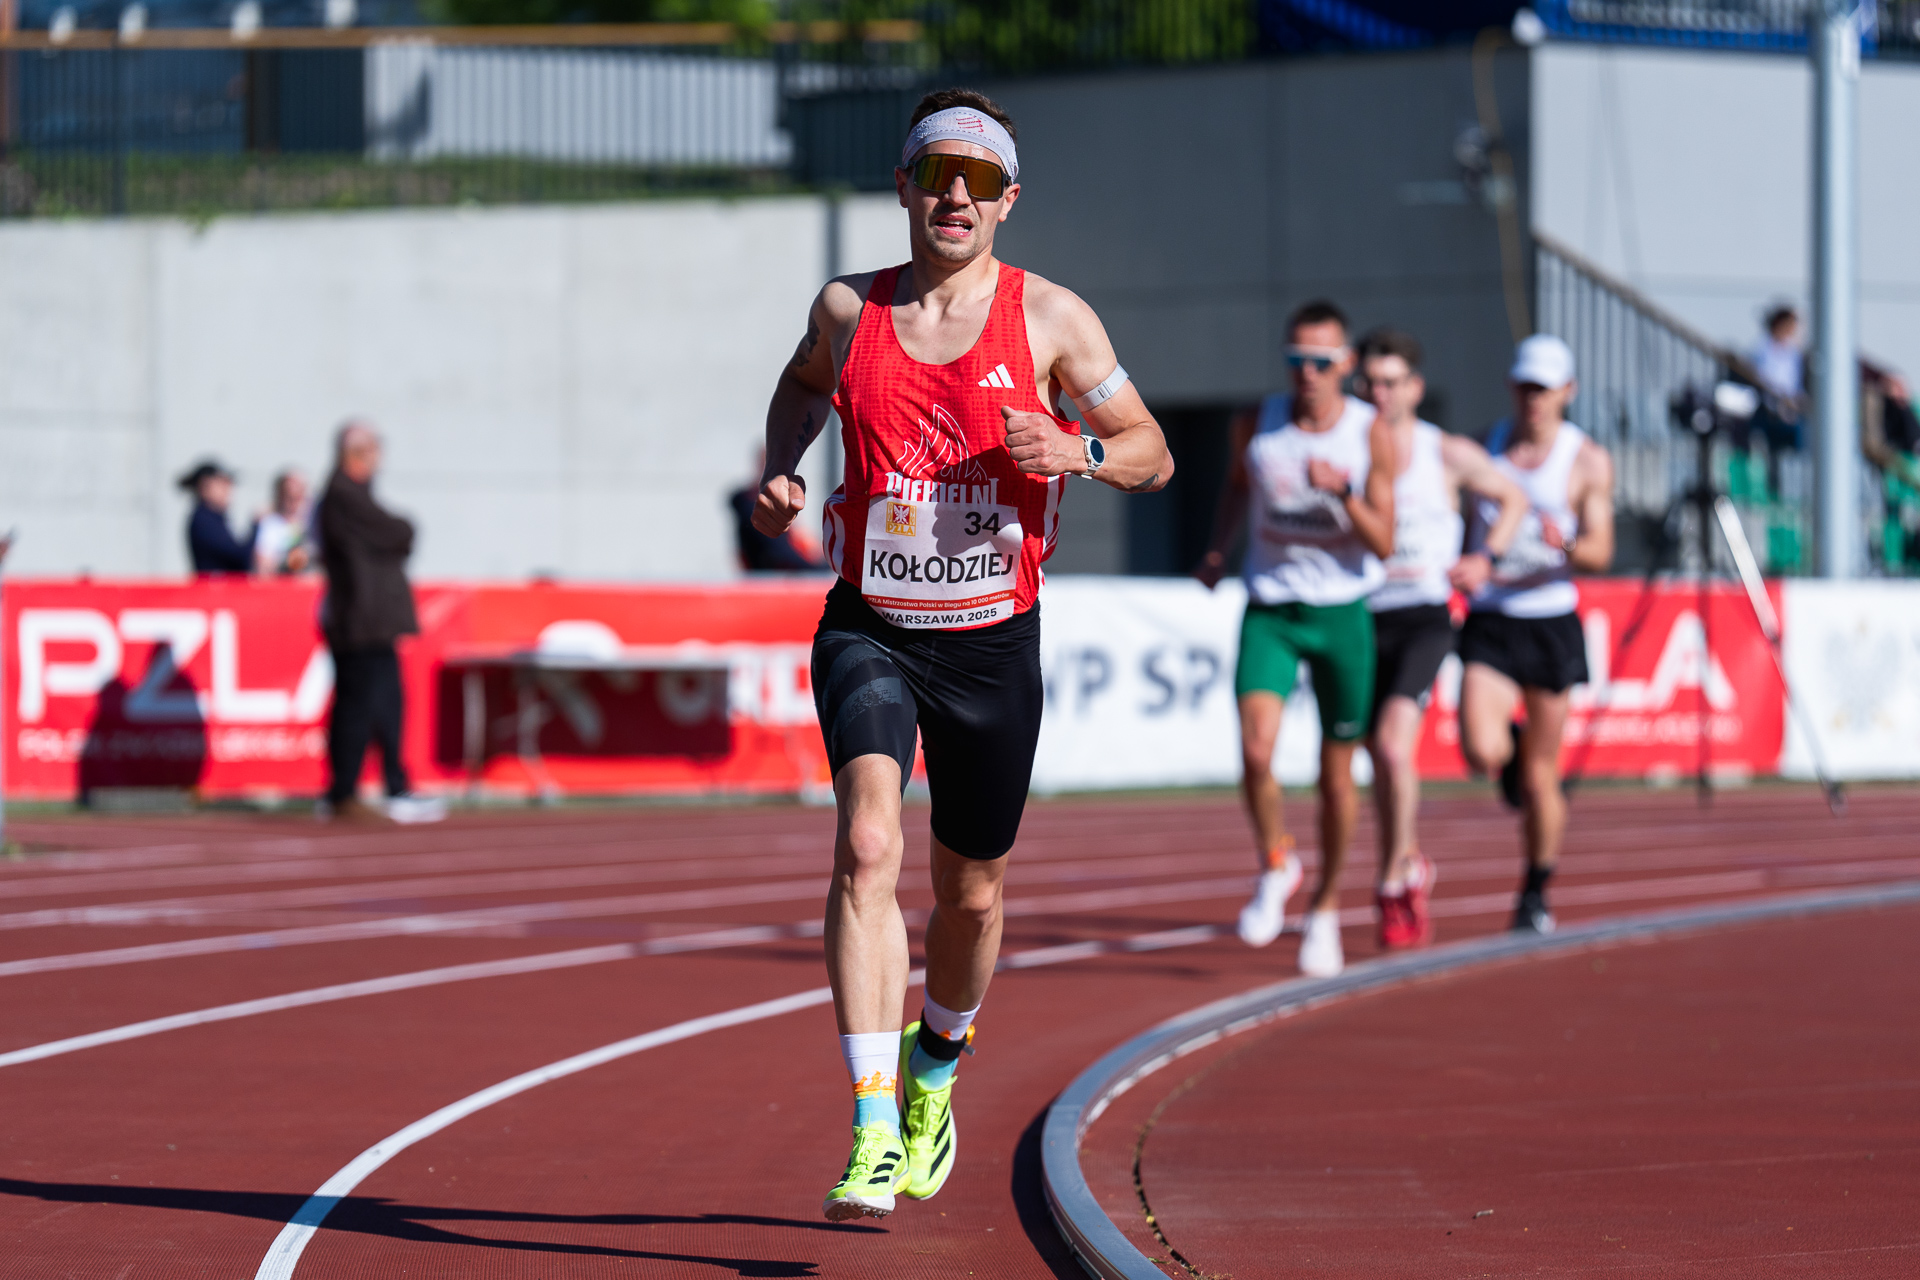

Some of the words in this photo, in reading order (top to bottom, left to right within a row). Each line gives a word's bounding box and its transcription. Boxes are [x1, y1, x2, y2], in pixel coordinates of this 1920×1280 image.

[887, 522, 914, 535] PZLA
[964, 511, 1000, 536] 34
[869, 549, 1014, 584] KOŁODZIEJ
[882, 599, 919, 607] Mistrzostwa
[989, 592, 1010, 601] metrów
[881, 611, 964, 625] WARSZAWA
[967, 608, 997, 622] 2025
